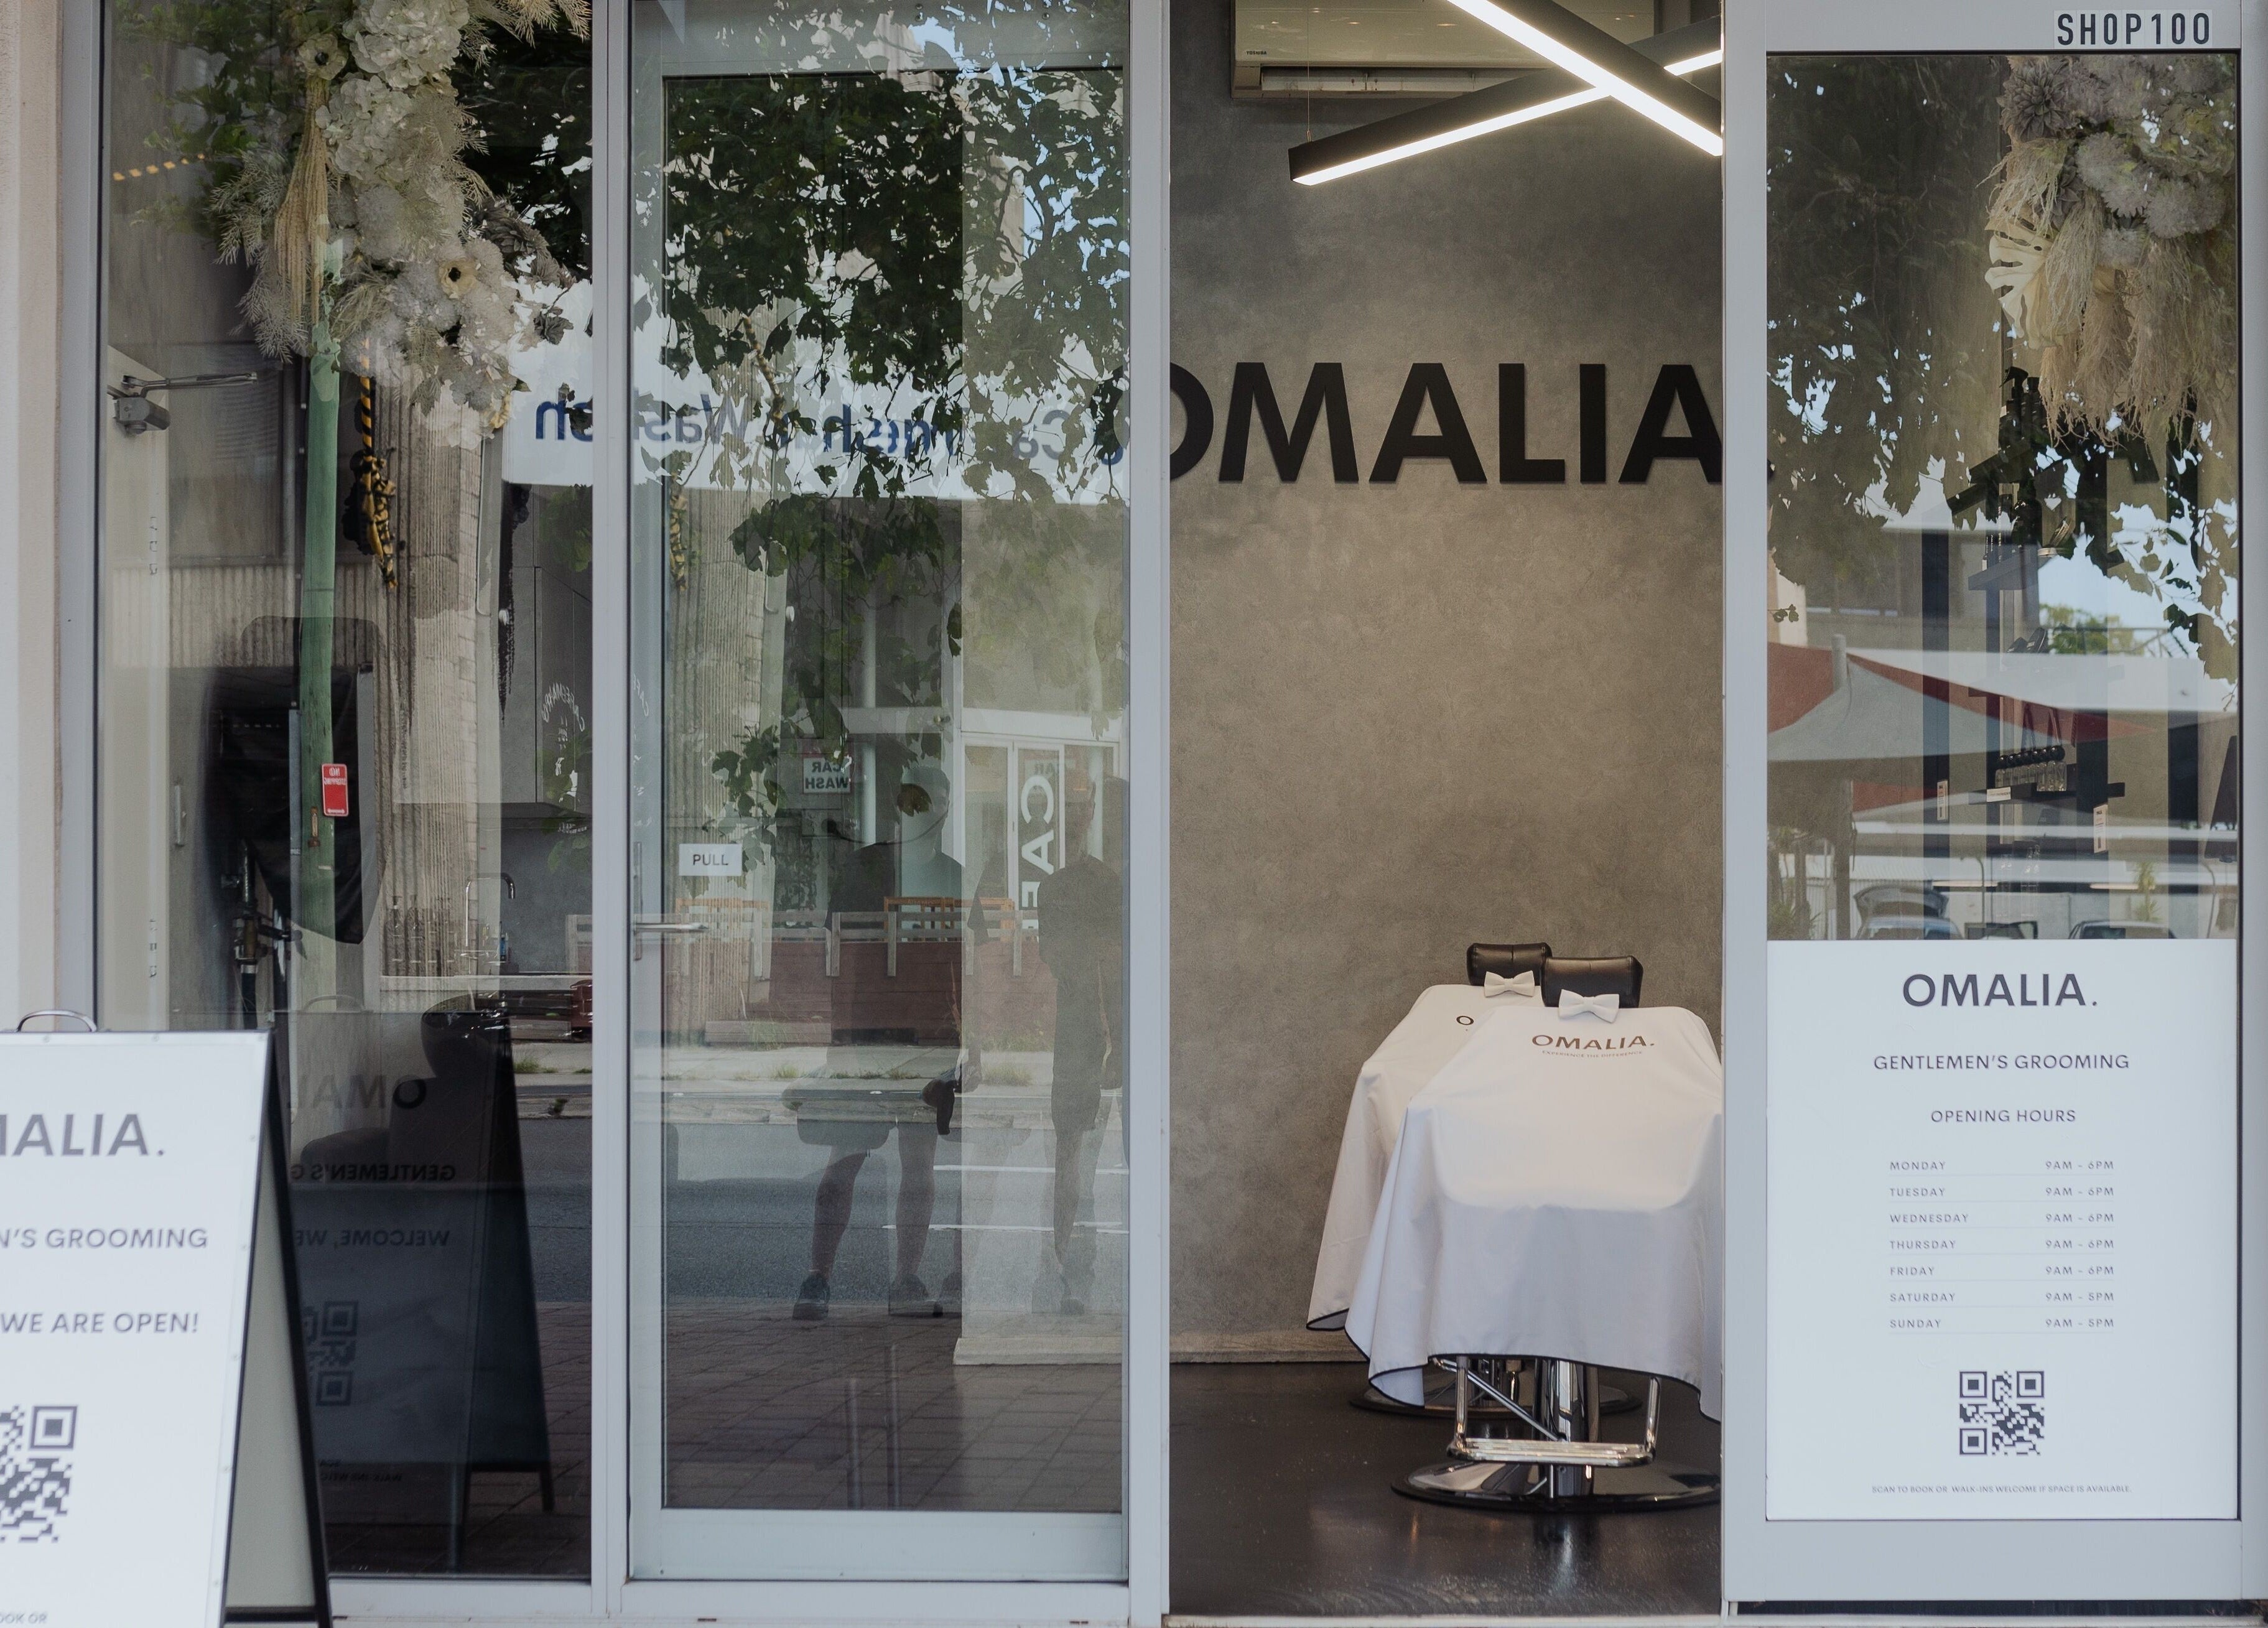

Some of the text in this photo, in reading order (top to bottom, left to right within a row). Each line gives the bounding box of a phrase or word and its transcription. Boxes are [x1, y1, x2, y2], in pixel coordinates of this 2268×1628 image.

[692, 854, 728, 865] PULL
[1902, 972, 2098, 1008] OMALIA.
[1531, 1035, 1655, 1050] OMALIA.
[1873, 1054, 2129, 1071] GENTLEMEN'S GROOMING
[1930, 1109, 2076, 1123] OPENING HOURS
[0, 1113, 165, 1157] ALIA.
[1890, 1161, 1945, 1170] MONDAY
[2045, 1161, 2072, 1170] 9AM
[2088, 1161, 2114, 1170] 6PM
[1890, 1188, 1945, 1197] TUESDAY
[2045, 1187, 2073, 1196] 9AM
[2088, 1187, 2114, 1196] 6PM
[1890, 1214, 1966, 1222] WEDNESDAY
[2045, 1214, 2072, 1222] 9AM
[2088, 1214, 2114, 1222] 6PM
[45, 1228, 208, 1249] GROOMING
[1890, 1240, 1954, 1250] THURSDAY
[2045, 1240, 2072, 1249] 9AM
[2088, 1239, 2114, 1249] 6PM
[1890, 1267, 1934, 1276] FRIDAY
[2045, 1266, 2072, 1275] 9AM
[2088, 1266, 2114, 1275] 6PM
[1890, 1293, 1954, 1302] SATURDAY
[2045, 1293, 2073, 1301] 9AM
[2088, 1292, 2114, 1301] 5PM
[0, 1313, 198, 1333] WE ARE OPEN!
[1890, 1319, 1940, 1328] SUNDAY
[2045, 1319, 2072, 1328] 9AM
[2088, 1318, 2114, 1327] 5PM
[27, 1611, 48, 1624] OR
